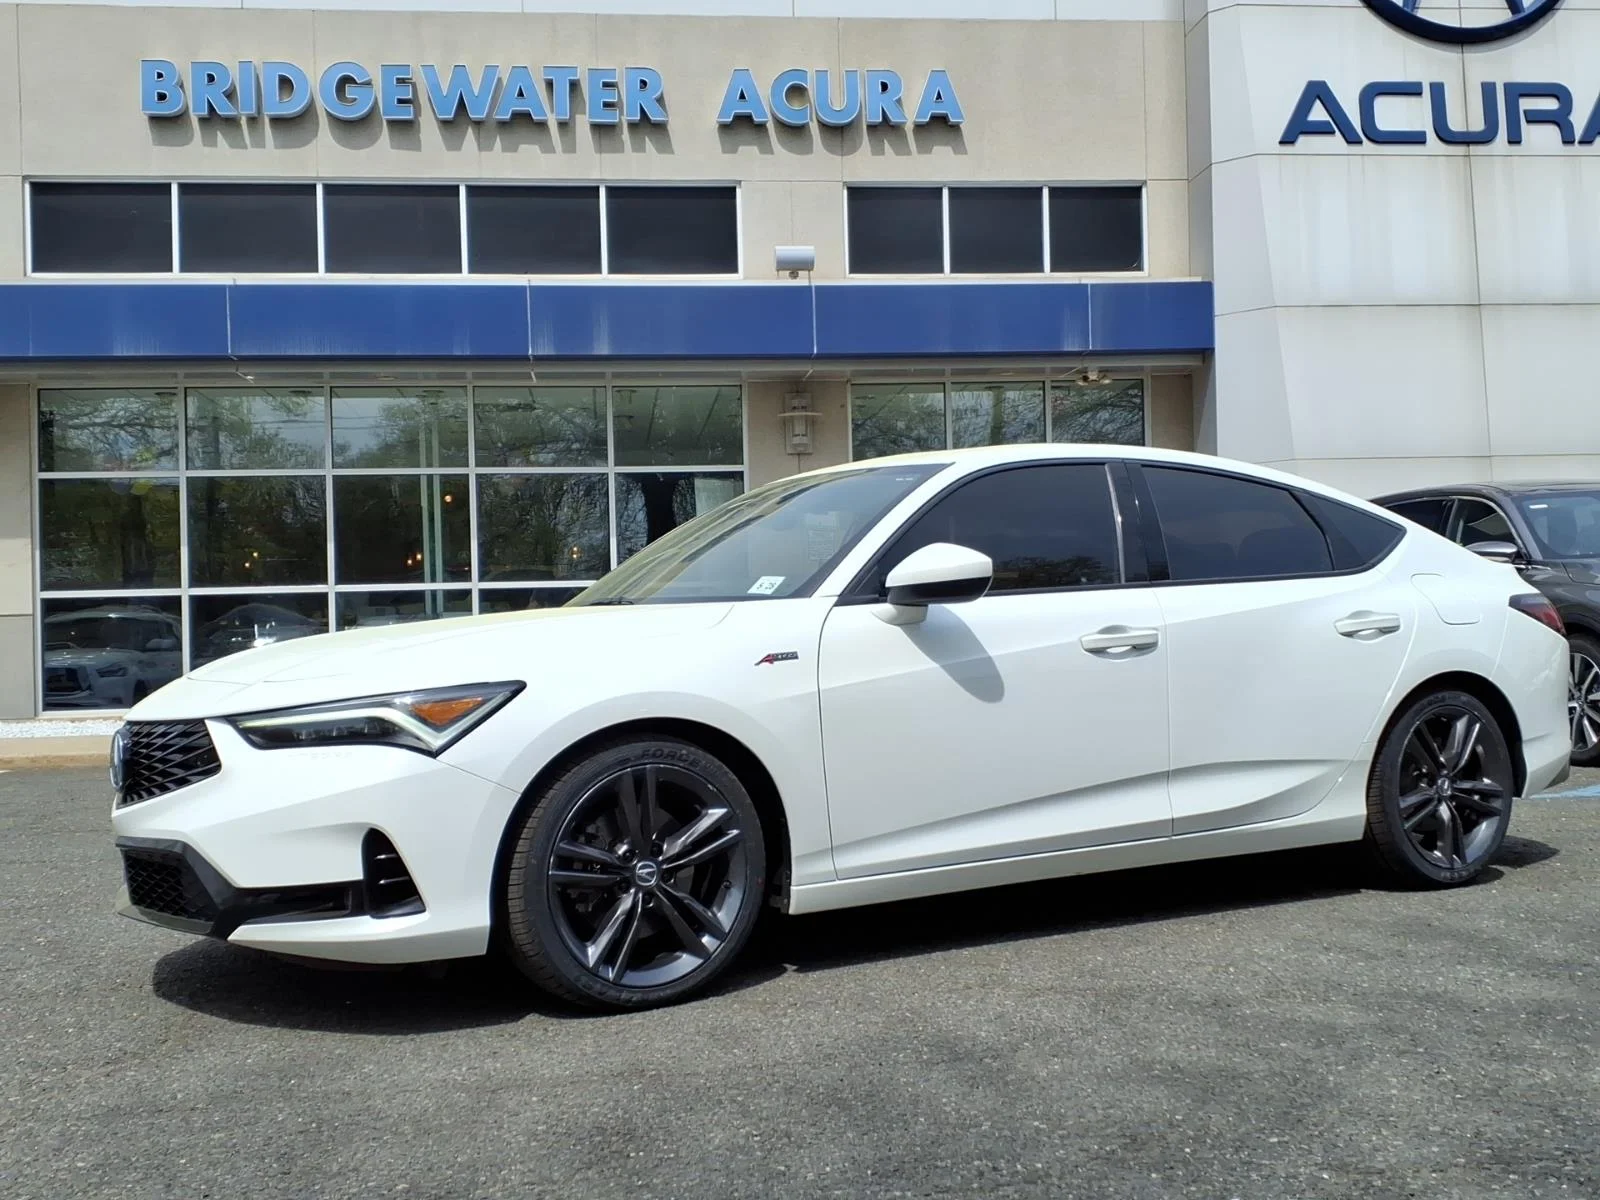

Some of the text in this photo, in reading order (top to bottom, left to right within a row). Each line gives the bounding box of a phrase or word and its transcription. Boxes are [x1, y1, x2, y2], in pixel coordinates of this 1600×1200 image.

[140, 58, 966, 127] BRIDGEWATER ACURA
[1278, 79, 1600, 146] ACUR
